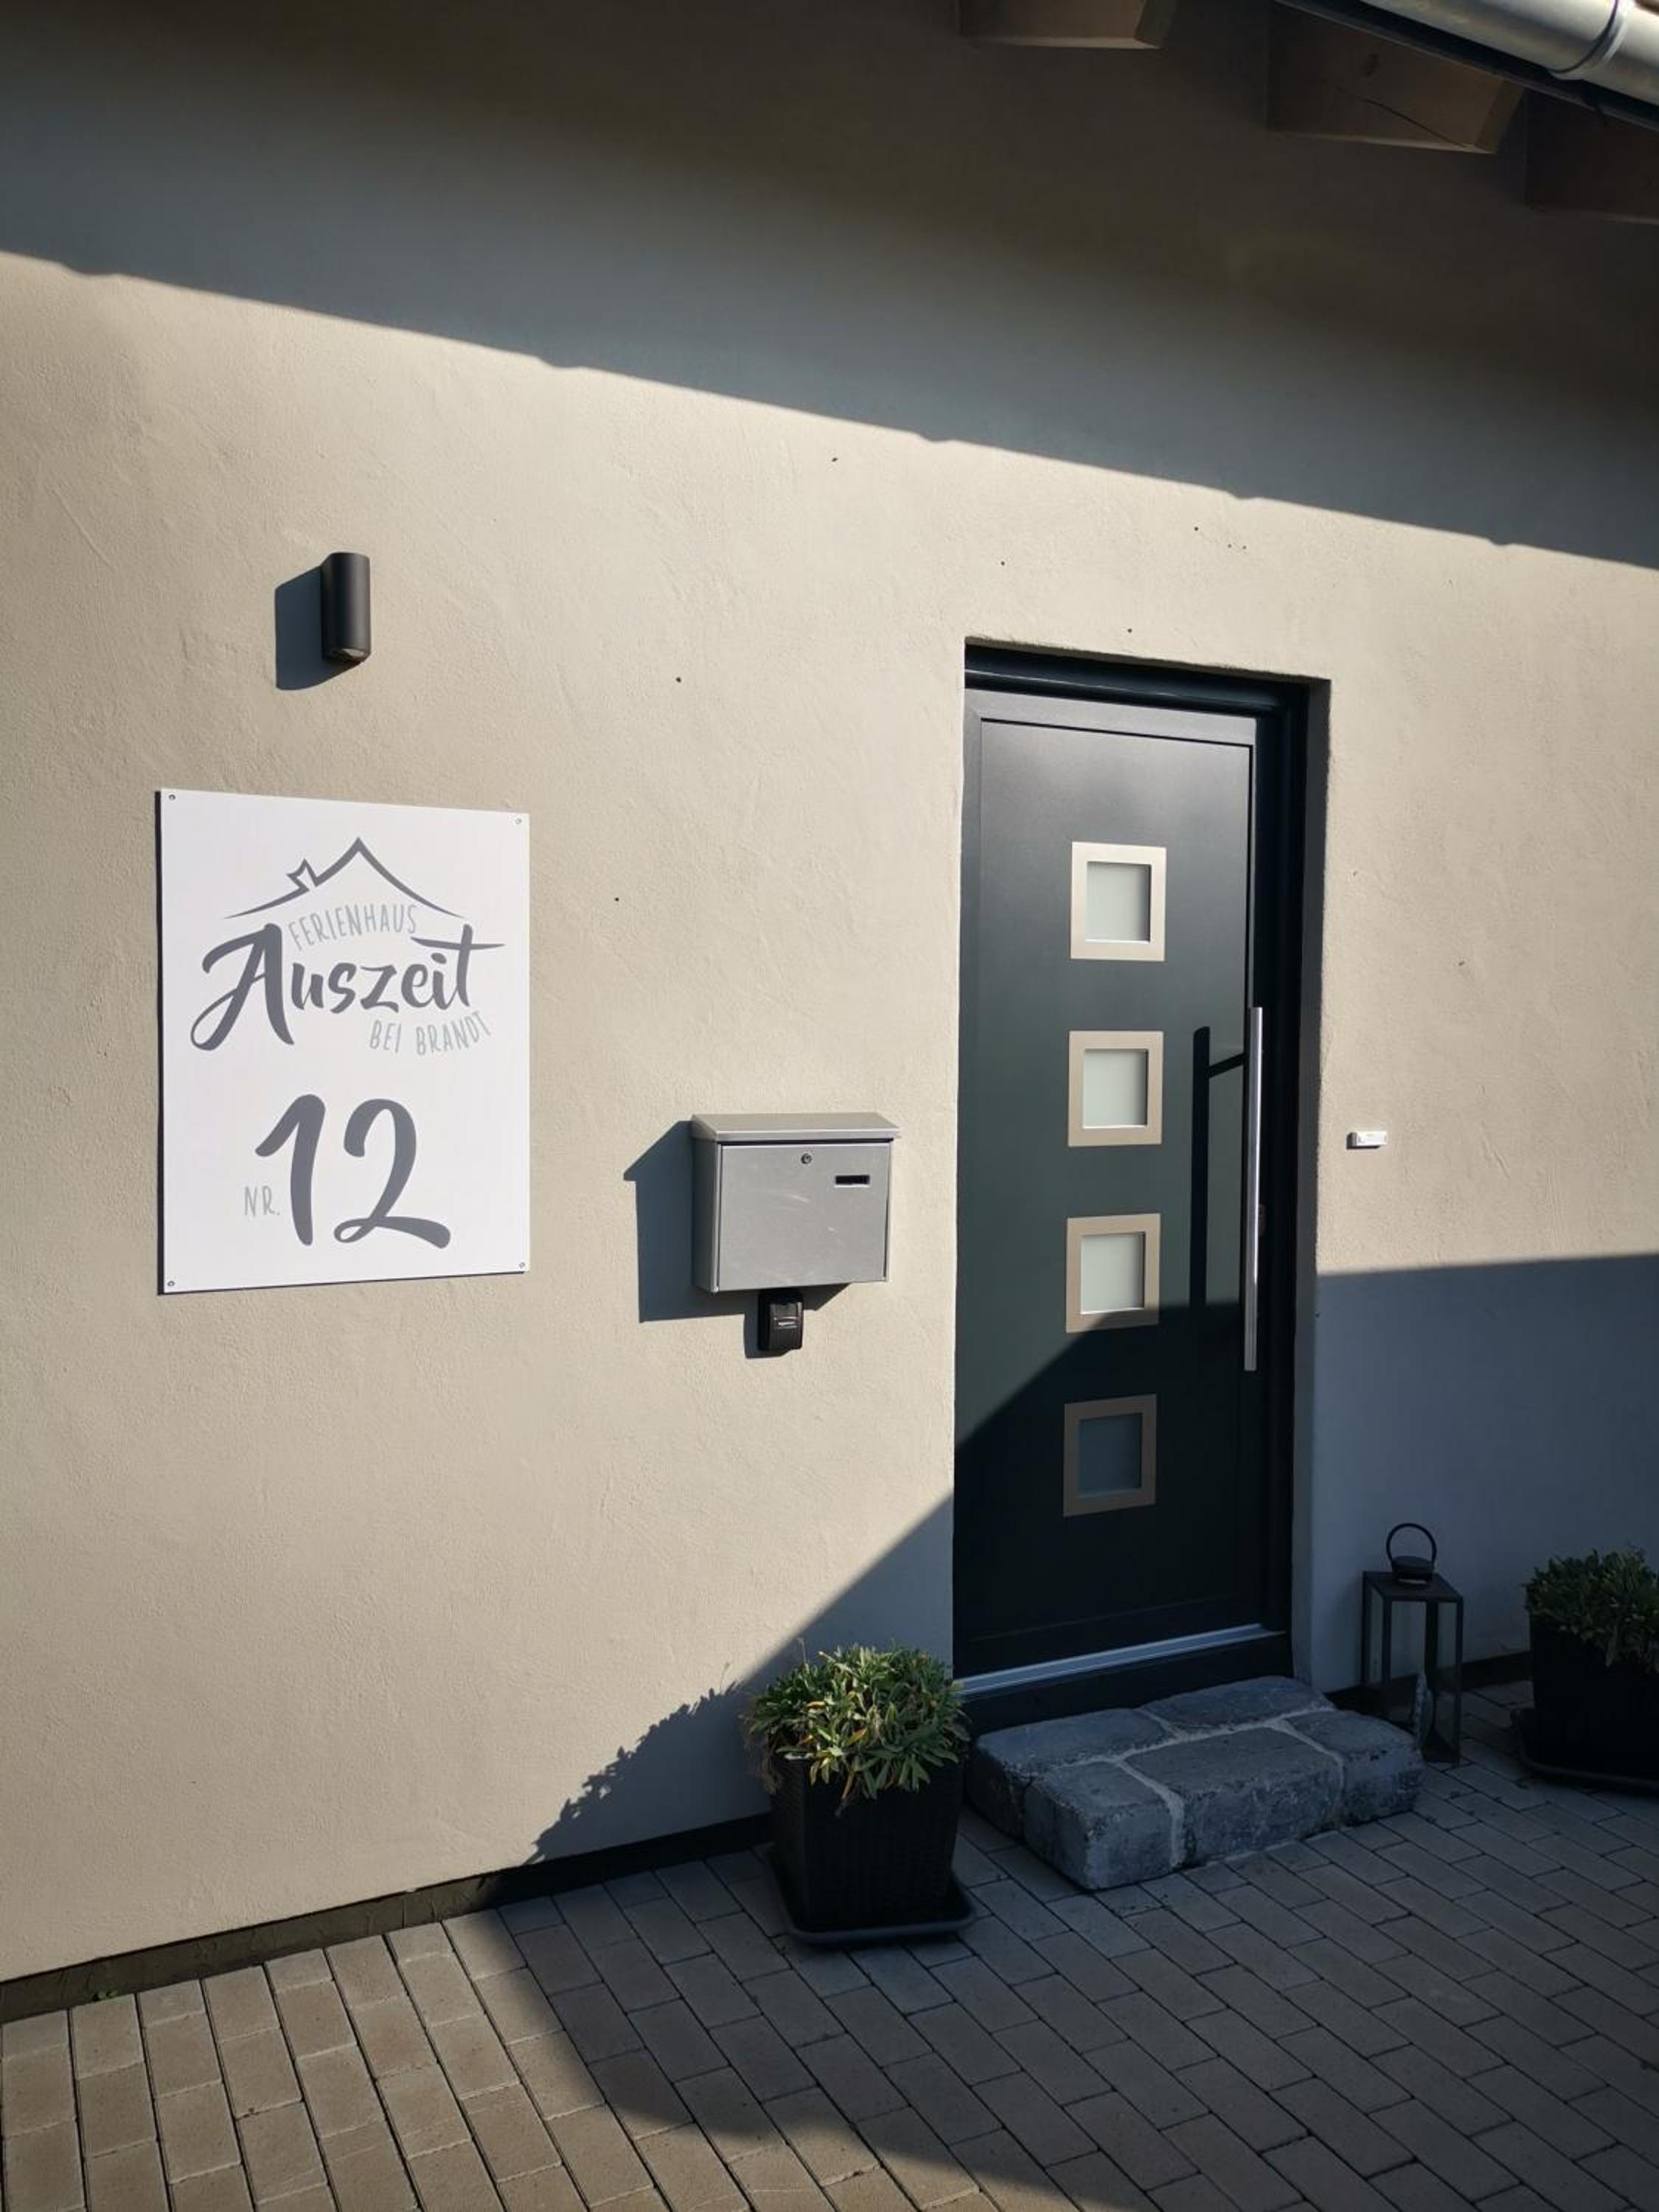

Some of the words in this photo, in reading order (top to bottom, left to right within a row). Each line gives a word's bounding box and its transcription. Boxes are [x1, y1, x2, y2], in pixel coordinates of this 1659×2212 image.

[289, 904, 420, 951] FERIENHAUS
[190, 922, 506, 1051] Auszeit
[369, 1020, 400, 1053] BEI
[416, 1010, 492, 1056] BRANDT
[255, 1094, 451, 1248] 12
[243, 1185, 281, 1217] NR.
